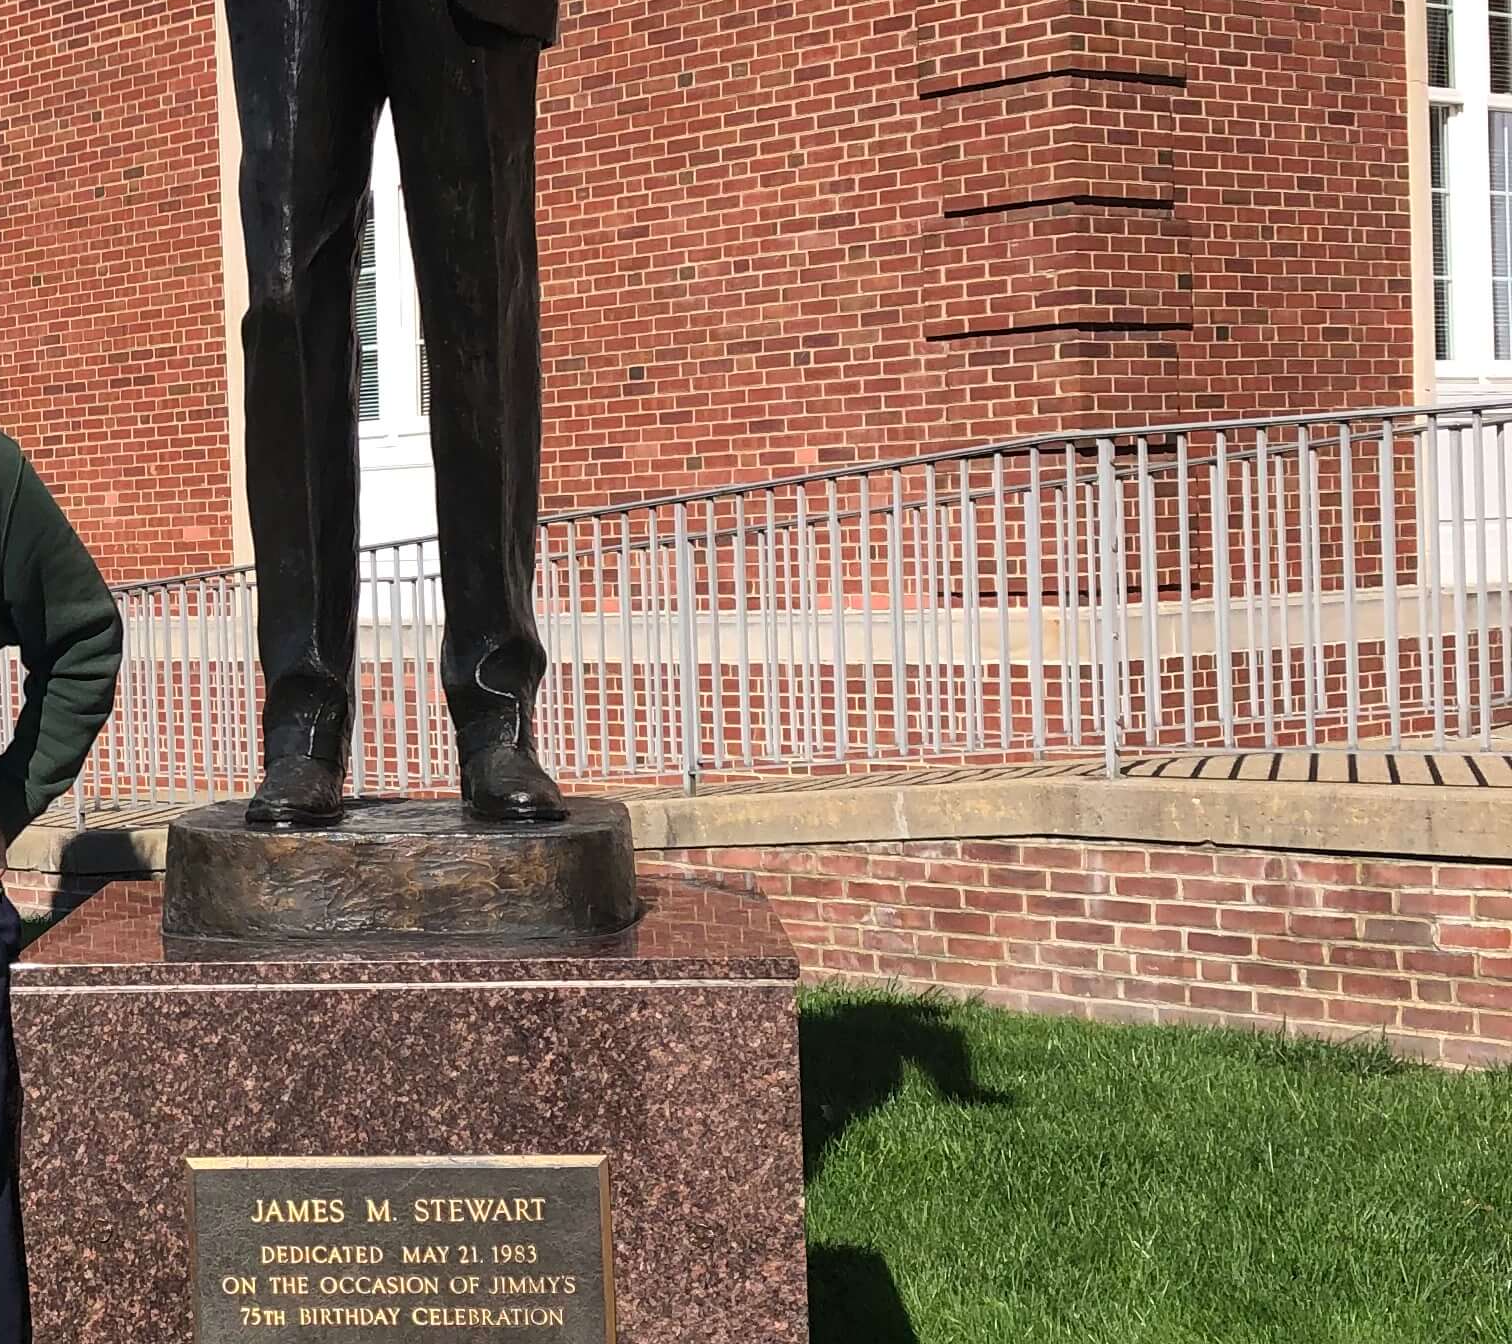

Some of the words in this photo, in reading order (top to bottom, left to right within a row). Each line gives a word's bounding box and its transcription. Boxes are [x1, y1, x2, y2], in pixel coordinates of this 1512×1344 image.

[251, 1199, 345, 1224] JAMES
[367, 1199, 398, 1223] M.
[414, 1198, 547, 1223] STEWART
[261, 1246, 383, 1265] DEDICATED
[402, 1246, 449, 1264] MAY
[491, 1245, 538, 1264] 1983
[222, 1277, 256, 1295] ON
[270, 1276, 309, 1294] THE
[320, 1276, 439, 1295] OCCASION
[450, 1276, 479, 1294] OF
[488, 1275, 576, 1295] JIMMY'S
[240, 1307, 285, 1325] 75TH
[300, 1308, 400, 1325] BIRTHDAY
[412, 1307, 564, 1326] CELEBRATION
